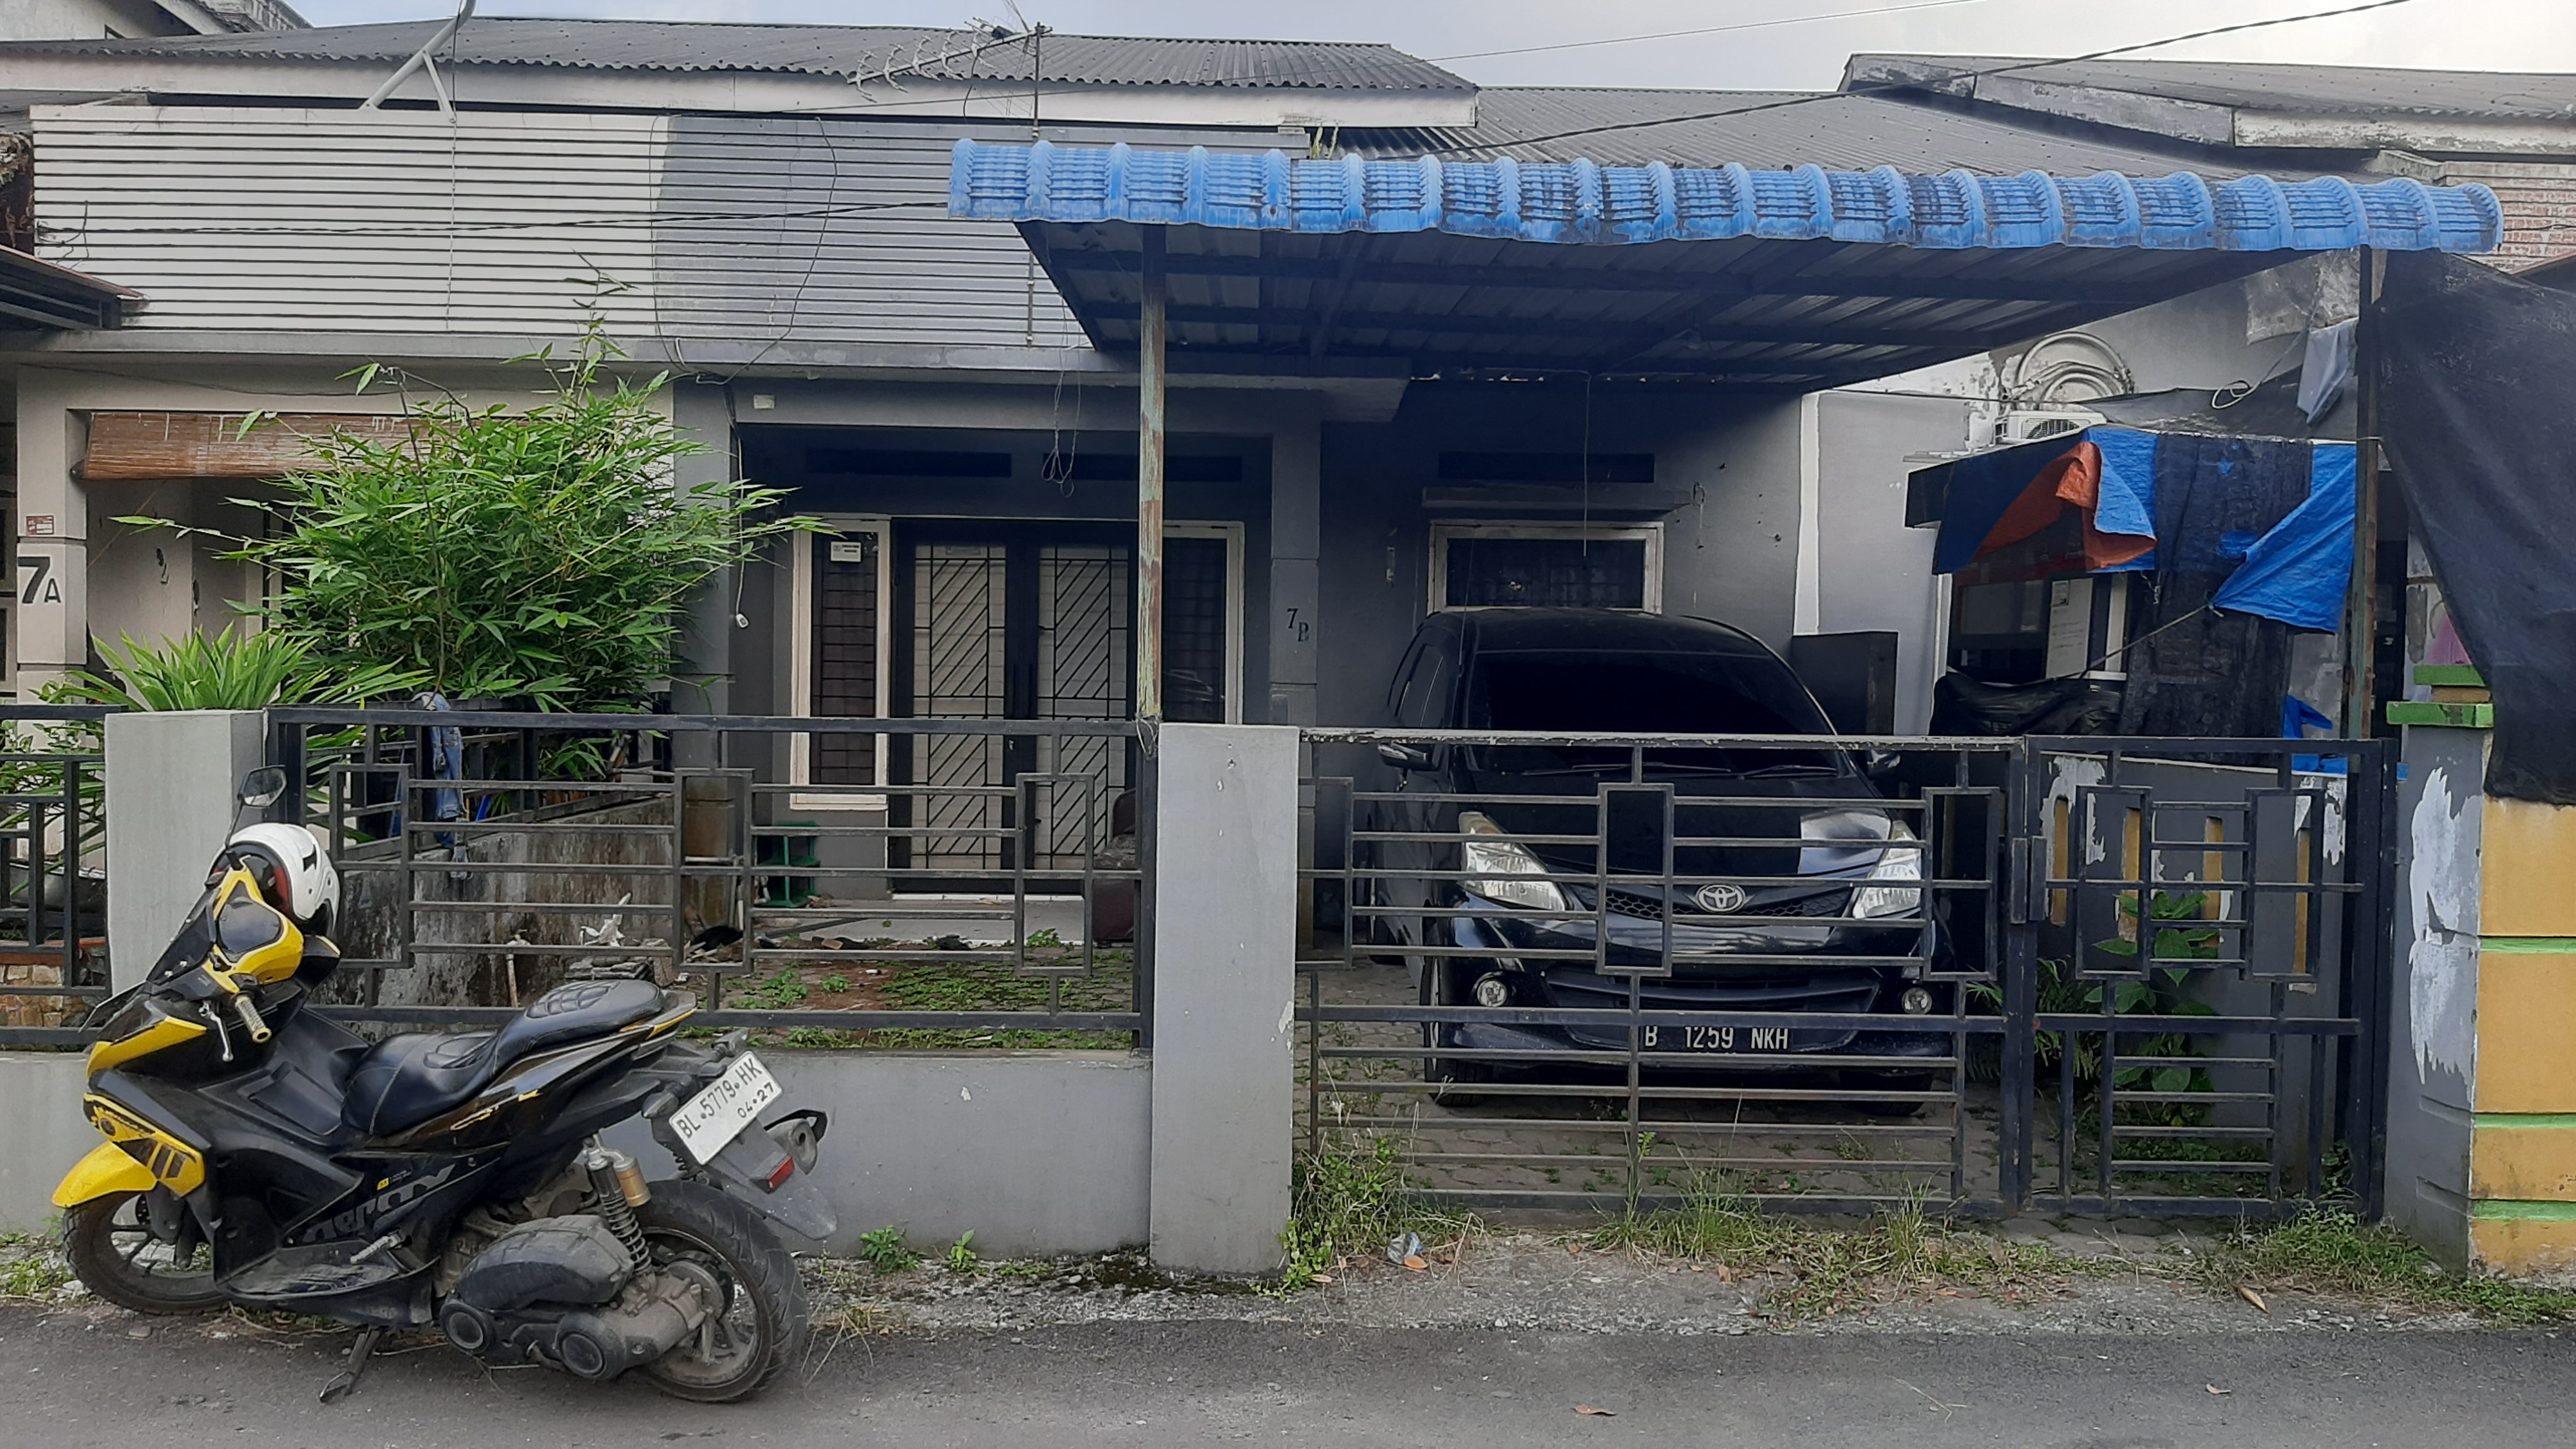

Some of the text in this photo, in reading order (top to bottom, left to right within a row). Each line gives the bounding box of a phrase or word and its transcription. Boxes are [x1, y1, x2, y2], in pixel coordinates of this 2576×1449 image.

[1645, 1025, 1789, 1050] B 1259 NKH
